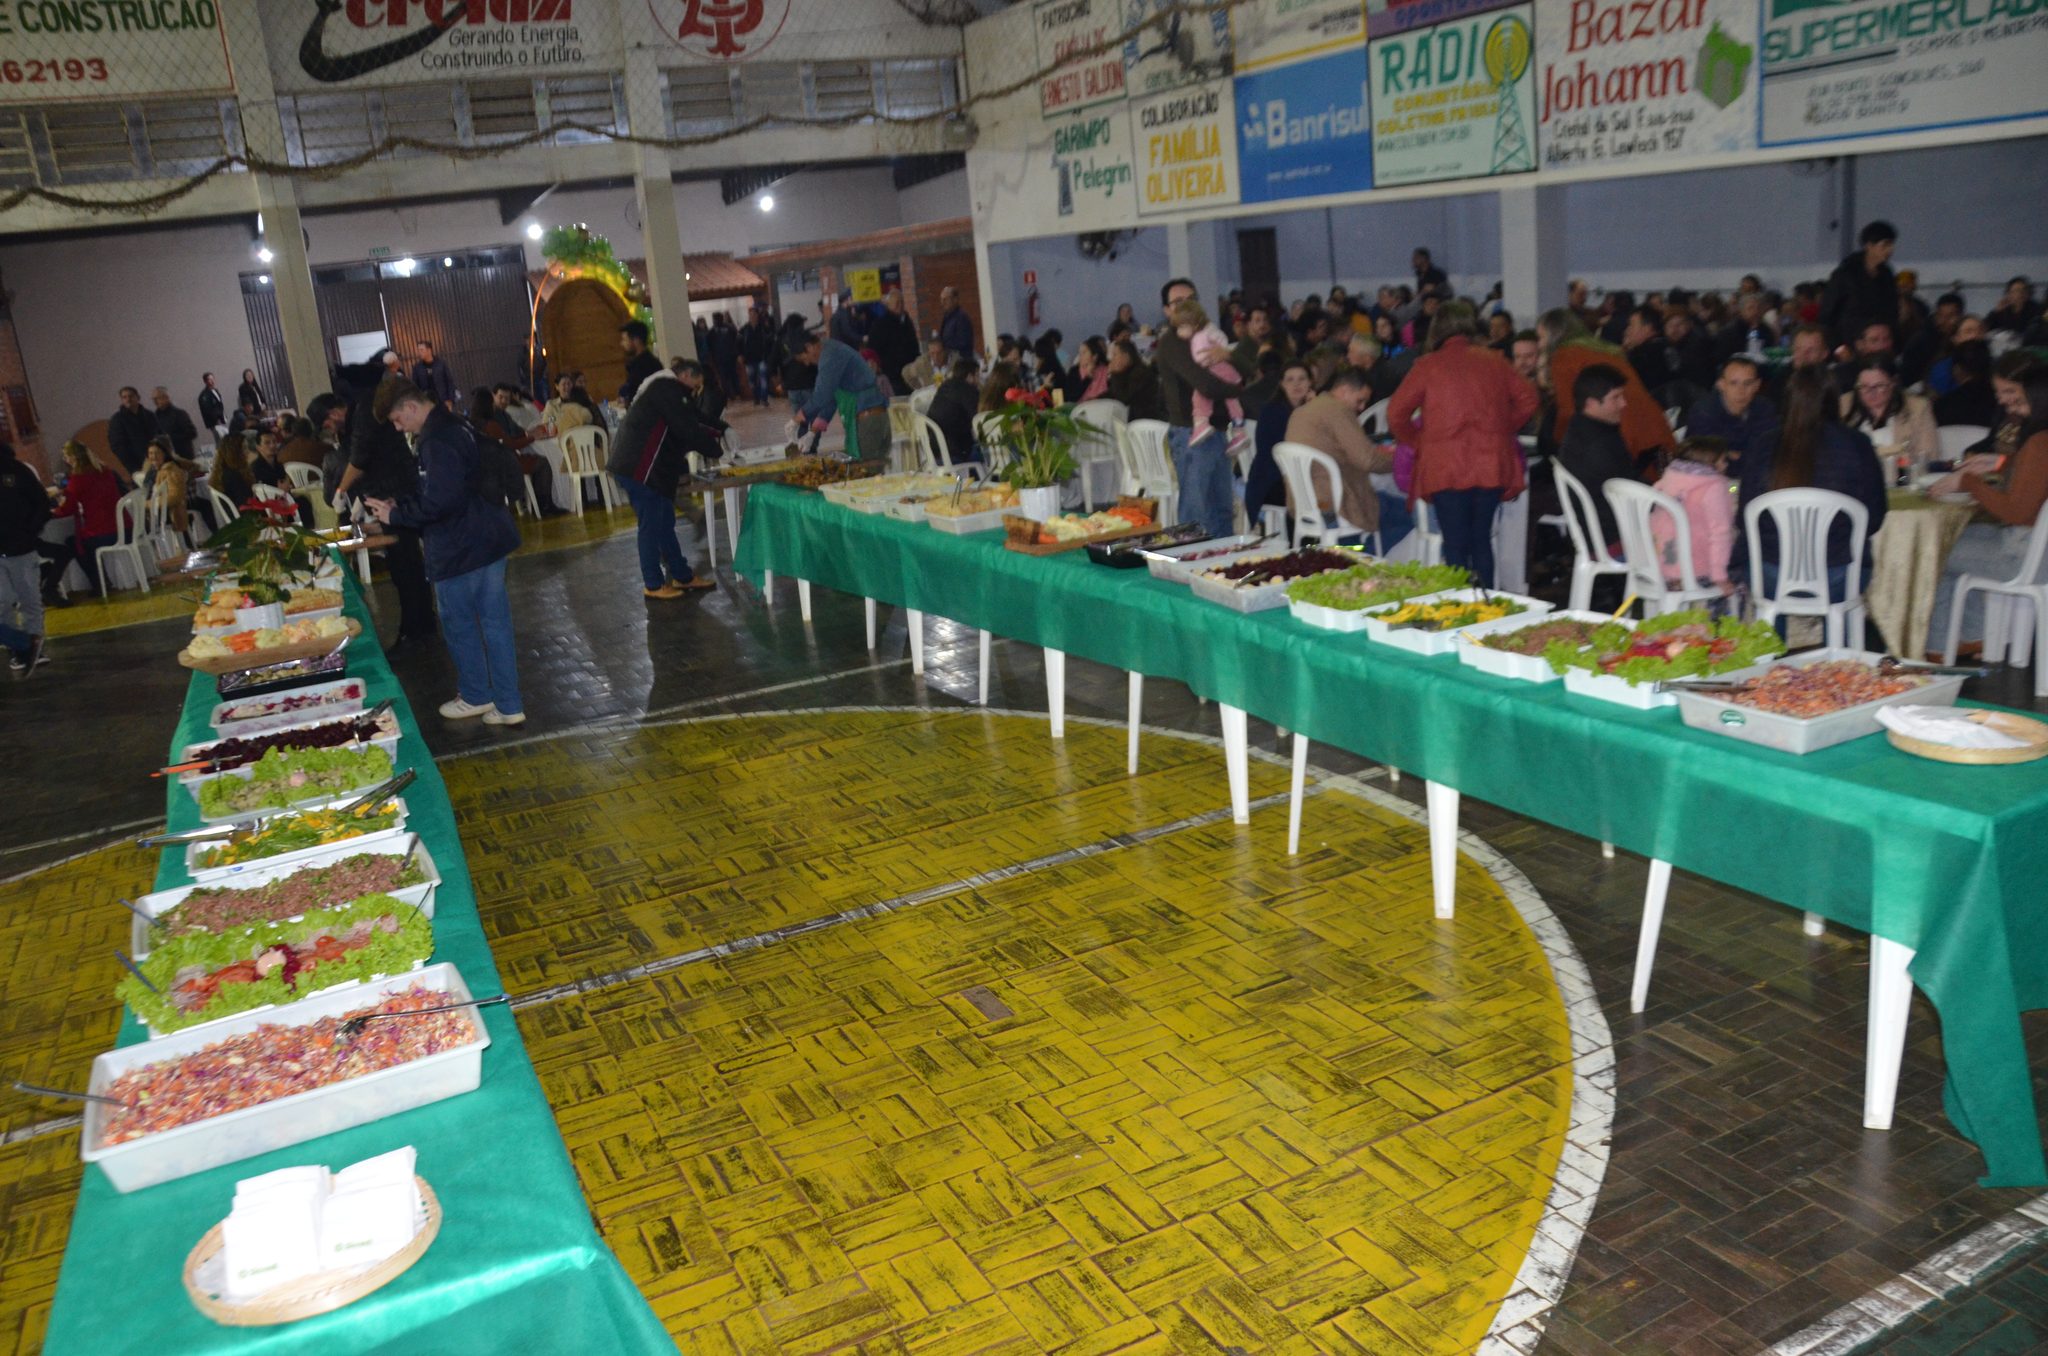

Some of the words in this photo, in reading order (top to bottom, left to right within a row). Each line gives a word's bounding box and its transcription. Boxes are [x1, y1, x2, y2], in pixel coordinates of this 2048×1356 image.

[450, 26, 515, 47] Gerando
[1566, 0, 1705, 54] Bazar
[0, 57, 109, 84] 62193
[421, 48, 513, 70] Construindo
[519, 52, 528, 65] o
[1541, 54, 1688, 124] Johann
[1266, 80, 1370, 149] Banrisul
[1073, 156, 1131, 197] Pelegrin
[1146, 160, 1227, 203] OLIVEIRA
